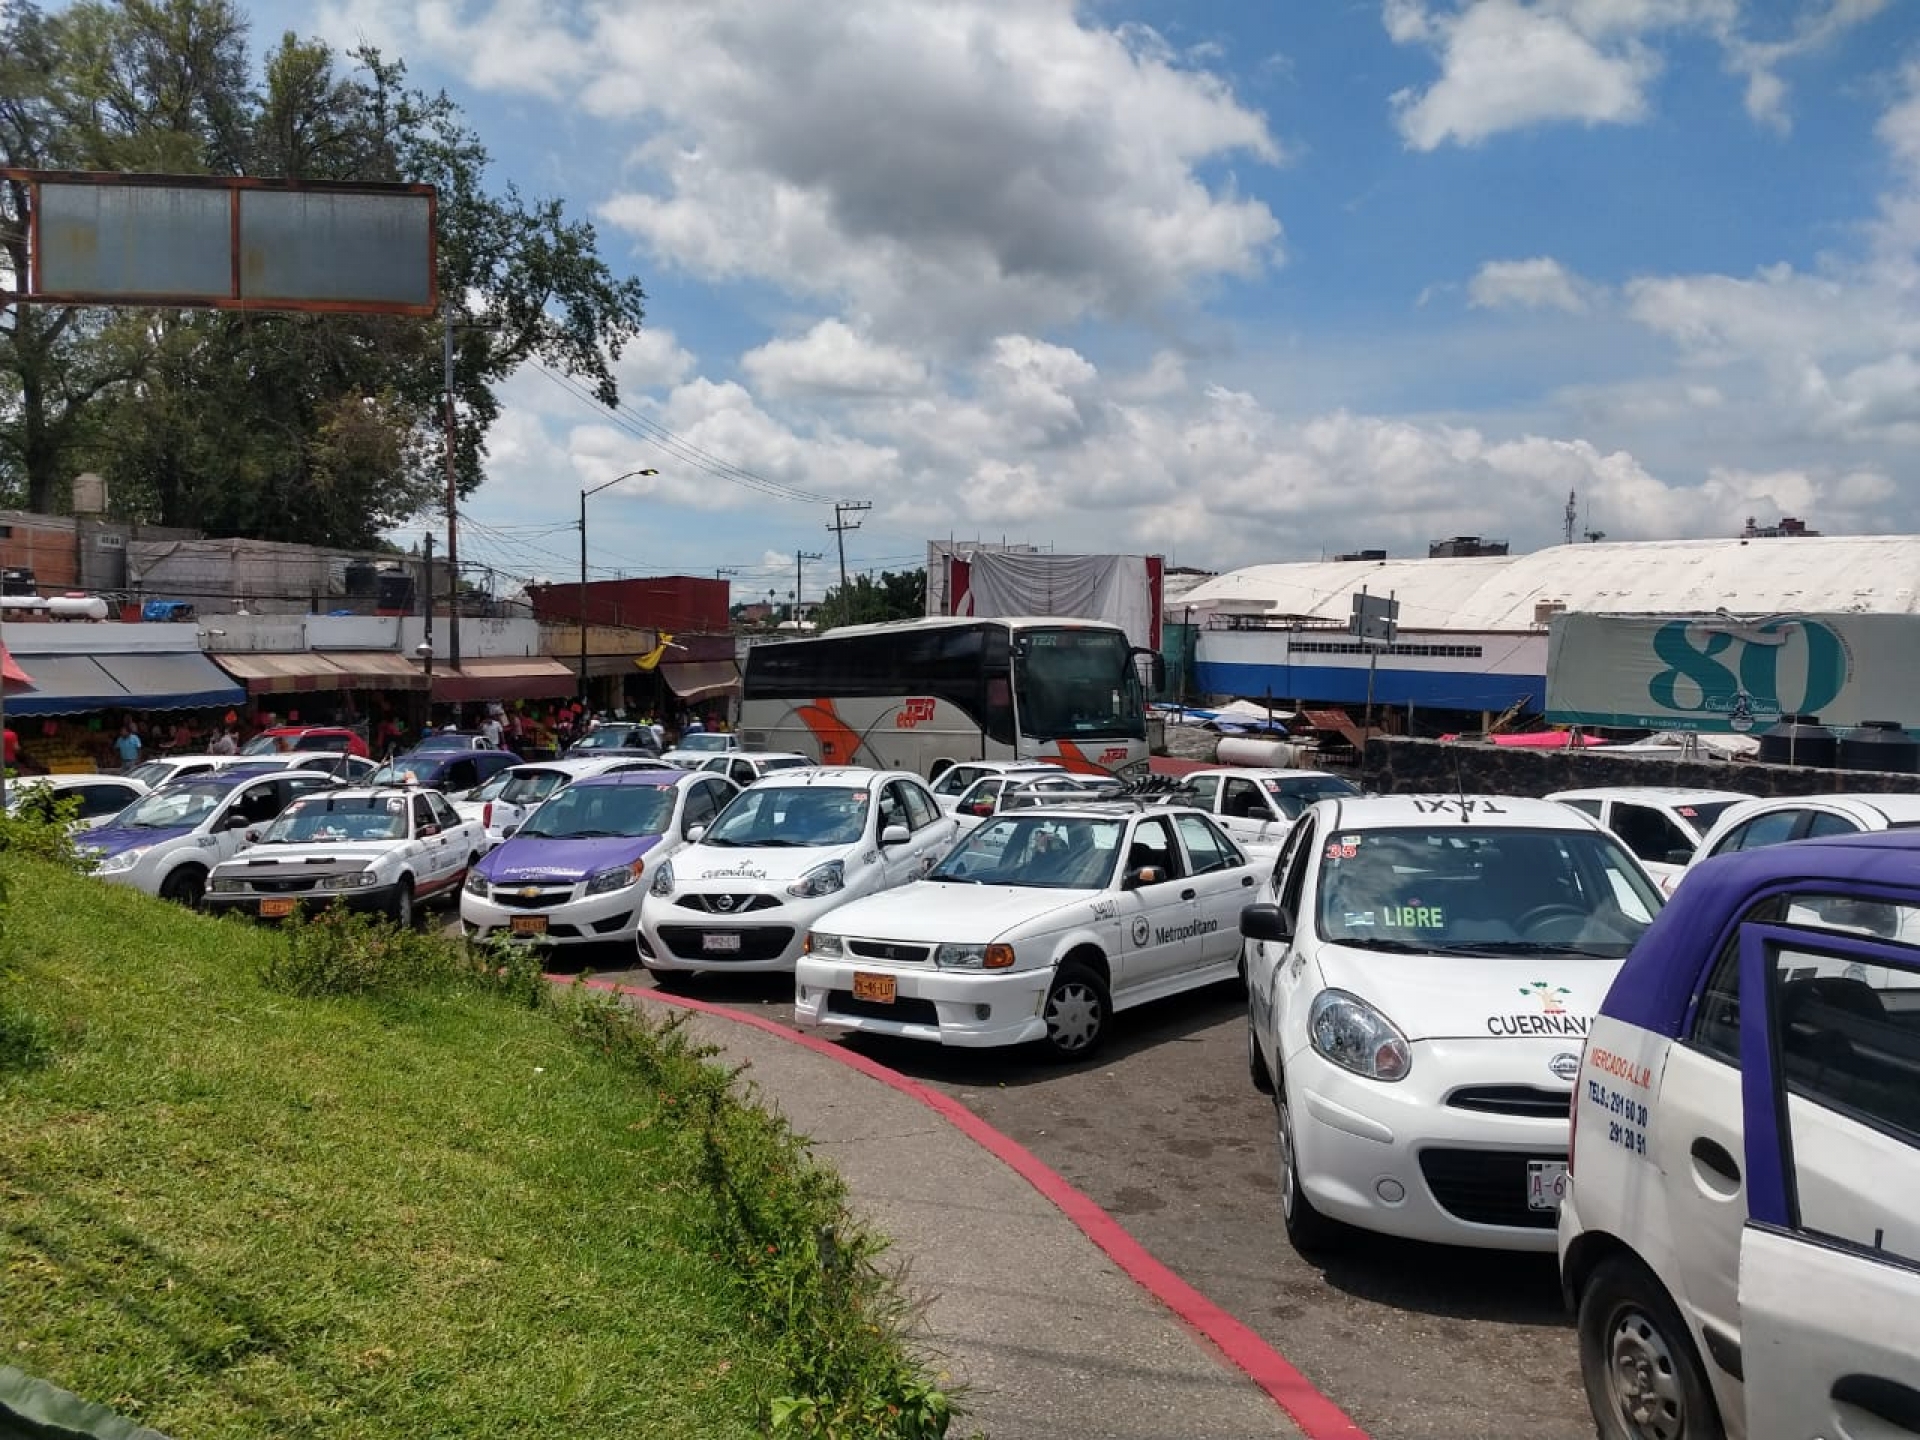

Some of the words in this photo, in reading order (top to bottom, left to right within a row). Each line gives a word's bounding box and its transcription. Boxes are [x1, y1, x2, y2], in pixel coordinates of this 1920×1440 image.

[1649, 618, 1847, 716] 80
[1413, 799, 1508, 813] TAXI
[1383, 905, 1444, 928] LIBRE
[1155, 918, 1218, 946] Metropolitano
[1590, 1047, 1627, 1078] MERCADO
[1610, 1091, 1624, 1116] 291
[1637, 1104, 1648, 1128] 30
[1609, 1120, 1623, 1144] 291
[1624, 1127, 1635, 1150] 20
[1637, 1133, 1647, 1156] 51
[1532, 1175, 1567, 1197] A-6
